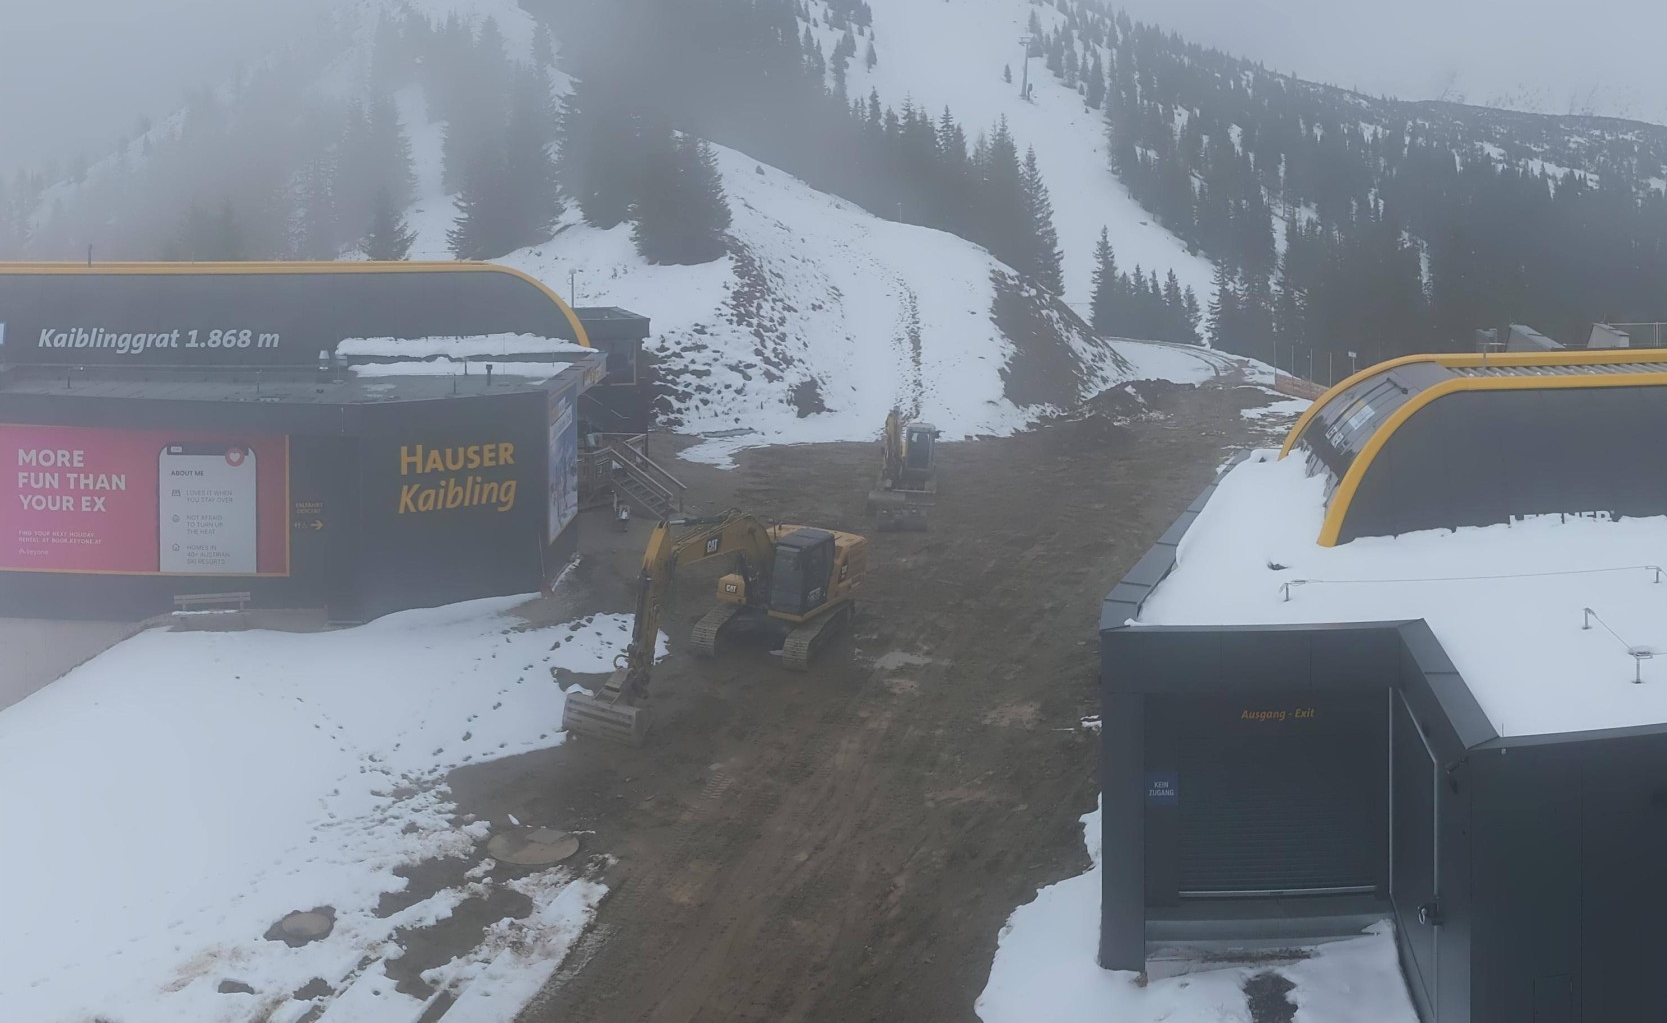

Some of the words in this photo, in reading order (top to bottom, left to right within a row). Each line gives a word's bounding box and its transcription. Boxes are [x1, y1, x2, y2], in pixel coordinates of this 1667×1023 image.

[38, 328, 179, 354] Kaiblinggrat
[185, 328, 251, 348] 1.868
[257, 333, 280, 348] m
[18, 449, 84, 467] MORE
[401, 442, 515, 475] HAUSER
[18, 472, 59, 489] FUN
[66, 473, 126, 490] THAN
[19, 494, 74, 511] YOUR
[81, 496, 106, 512] EX
[398, 476, 517, 513] Kaibling
[707, 539, 718, 553] CAT
[725, 584, 737, 593] CAT
[1241, 709, 1286, 721] Ausgang
[1295, 707, 1315, 718] Exit
[1149, 789, 1174, 797] ZUGANG
